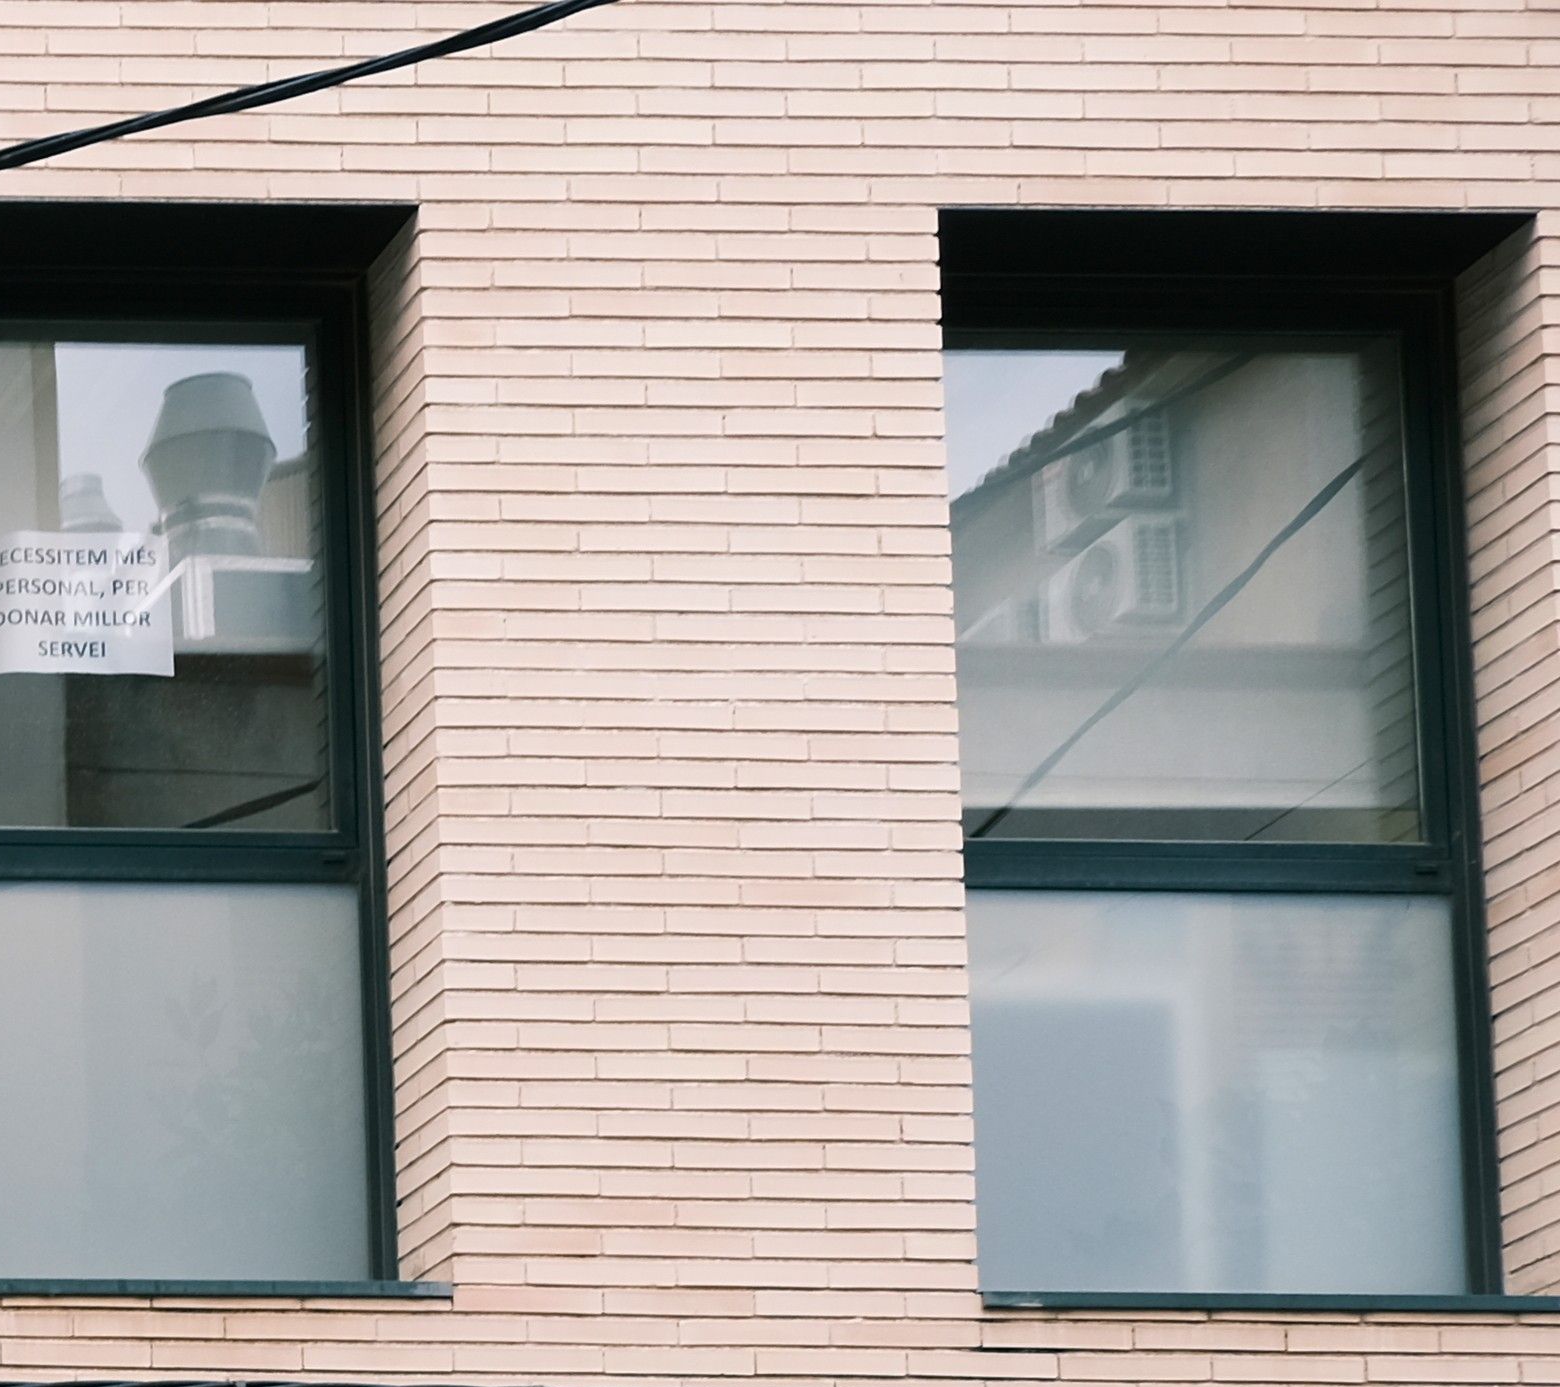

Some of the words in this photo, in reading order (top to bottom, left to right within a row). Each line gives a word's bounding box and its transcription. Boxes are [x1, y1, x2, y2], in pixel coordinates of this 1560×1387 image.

[116, 546, 156, 565] MÉS
[113, 579, 148, 595] PER
[74, 611, 150, 627] MILLOR
[38, 641, 106, 657] SERVEI
